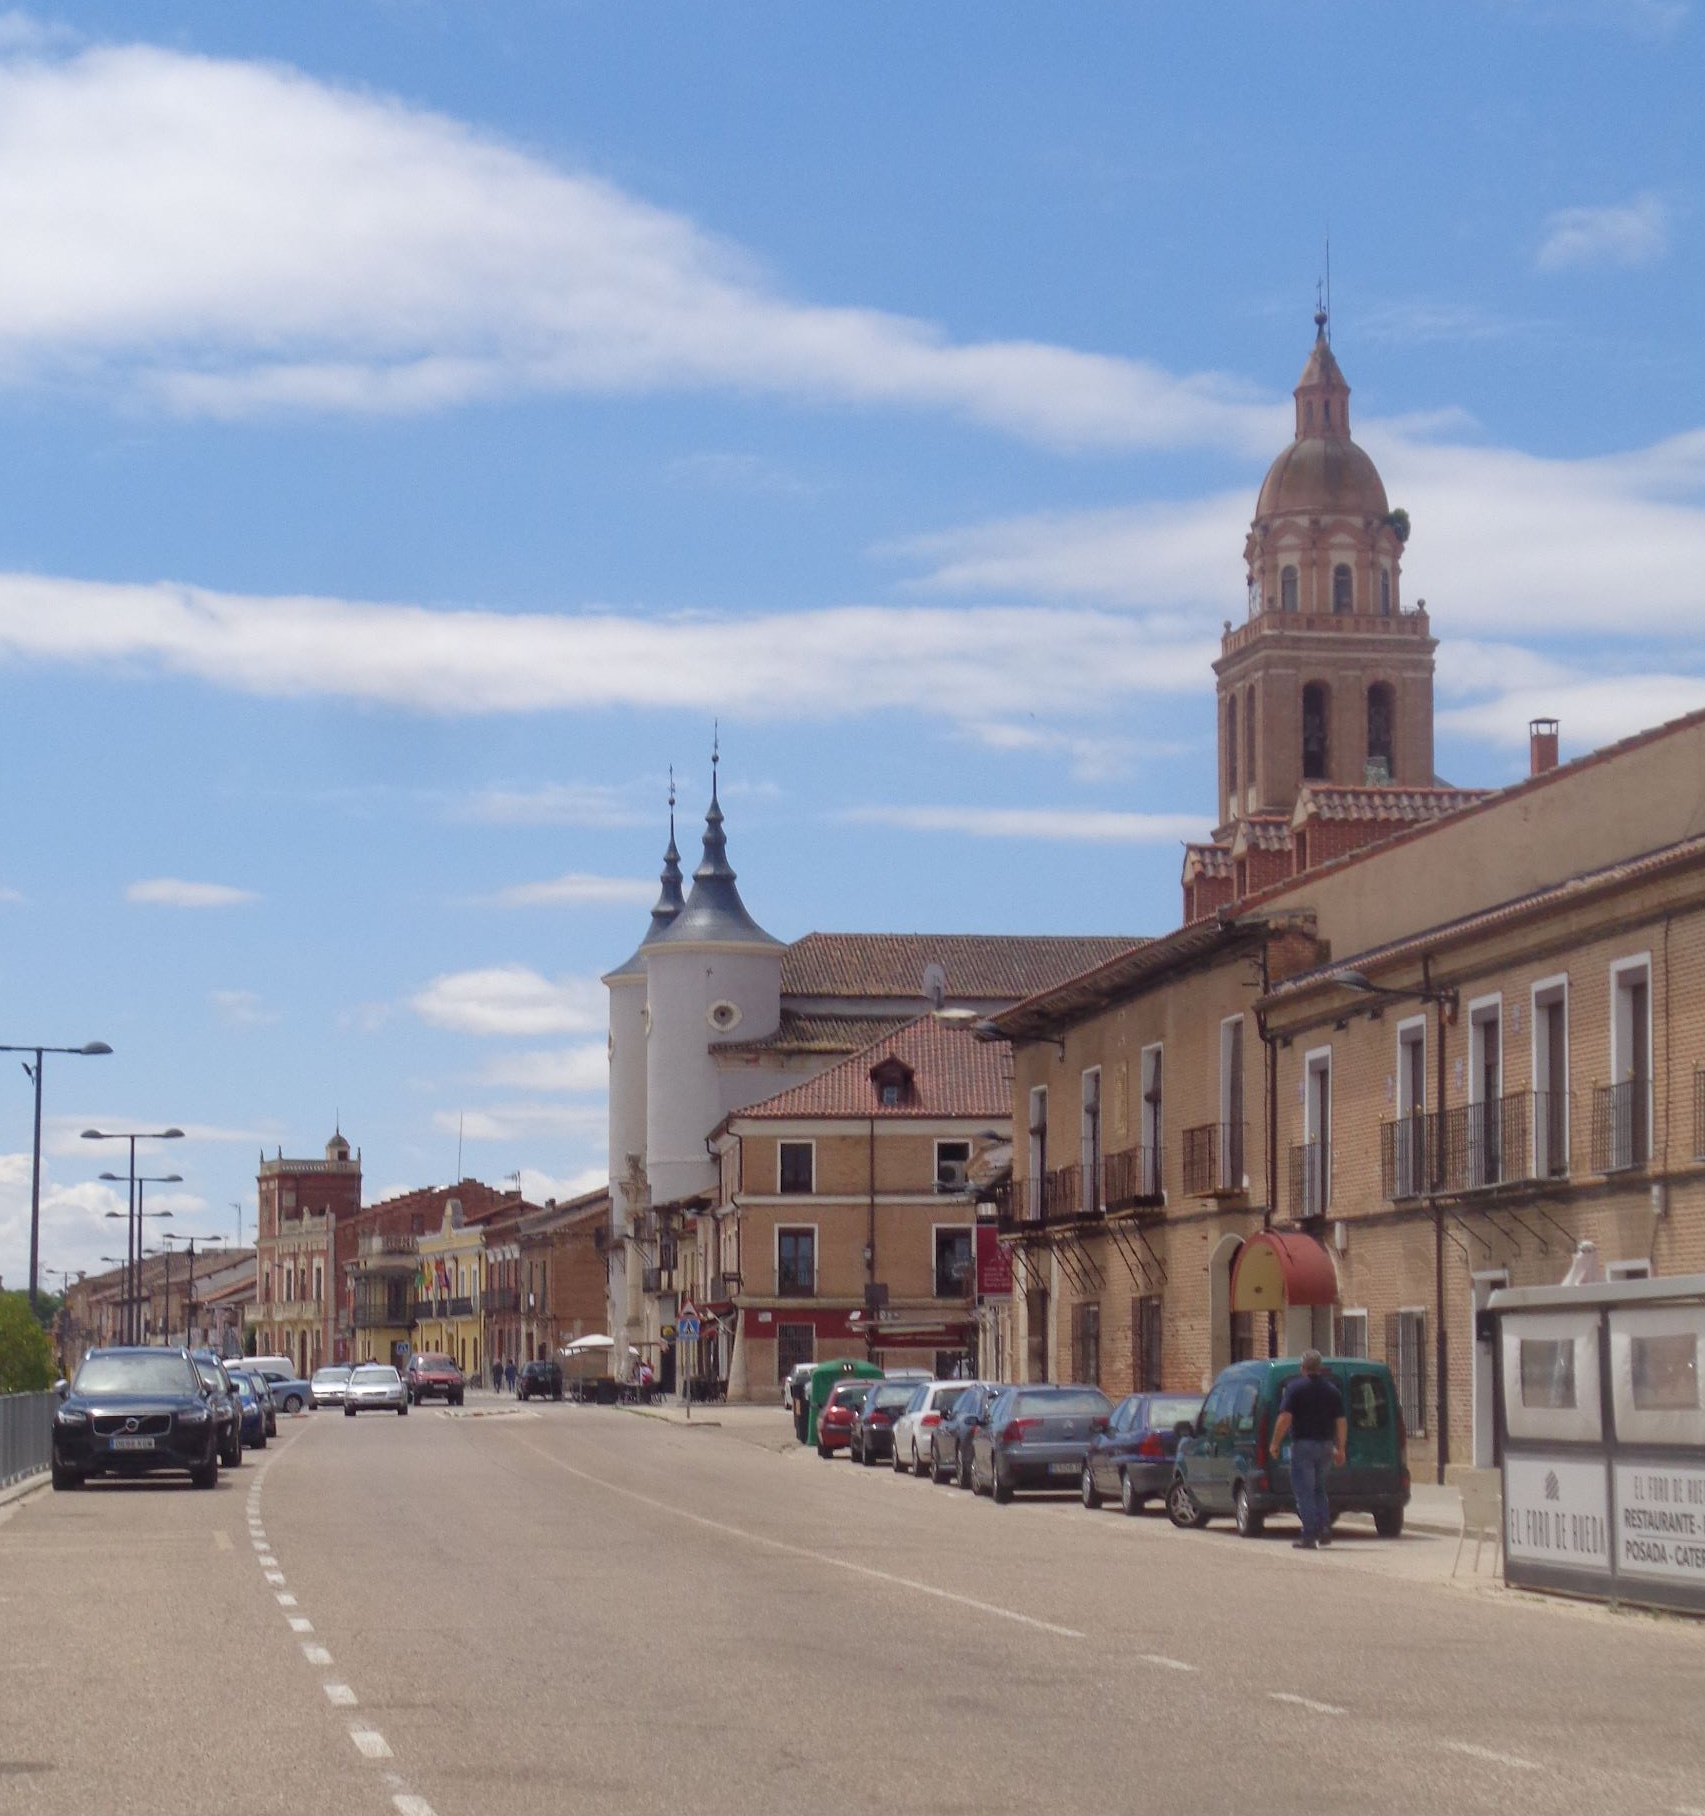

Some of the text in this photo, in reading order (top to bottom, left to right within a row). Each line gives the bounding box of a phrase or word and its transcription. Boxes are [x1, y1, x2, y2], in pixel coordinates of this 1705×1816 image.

[1634, 1476, 1705, 1505] EL FORO DE RUE
[1510, 1508, 1606, 1554] EL FORO DE RUEDA
[1625, 1509, 1696, 1535] RESTAURANTE
[1627, 1541, 1669, 1565] POSADA
